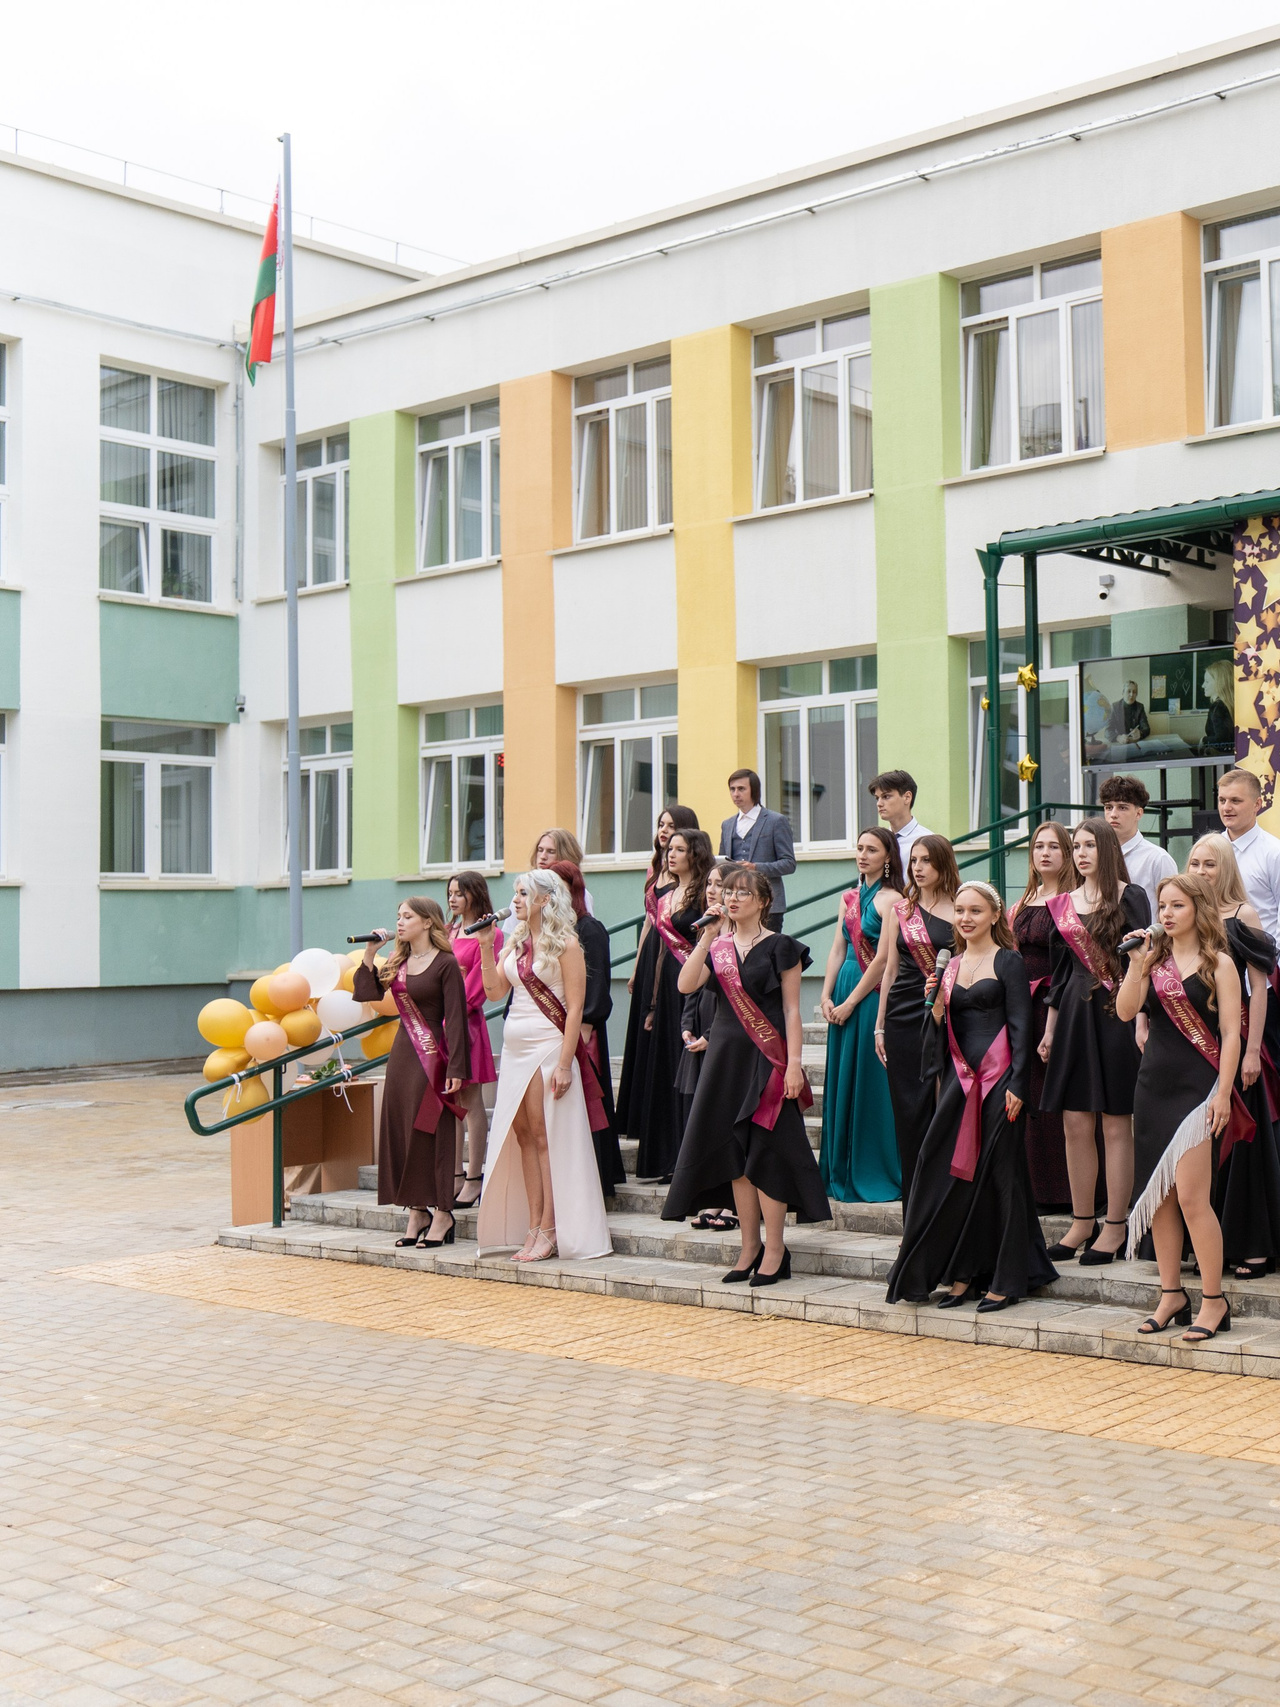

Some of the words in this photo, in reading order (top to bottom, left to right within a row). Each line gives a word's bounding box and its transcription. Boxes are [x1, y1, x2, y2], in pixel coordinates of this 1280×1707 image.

[1162, 978, 1207, 1051] Выпускница
[751, 1018, 776, 1043] 2024
[418, 1033, 437, 1055] 2024
